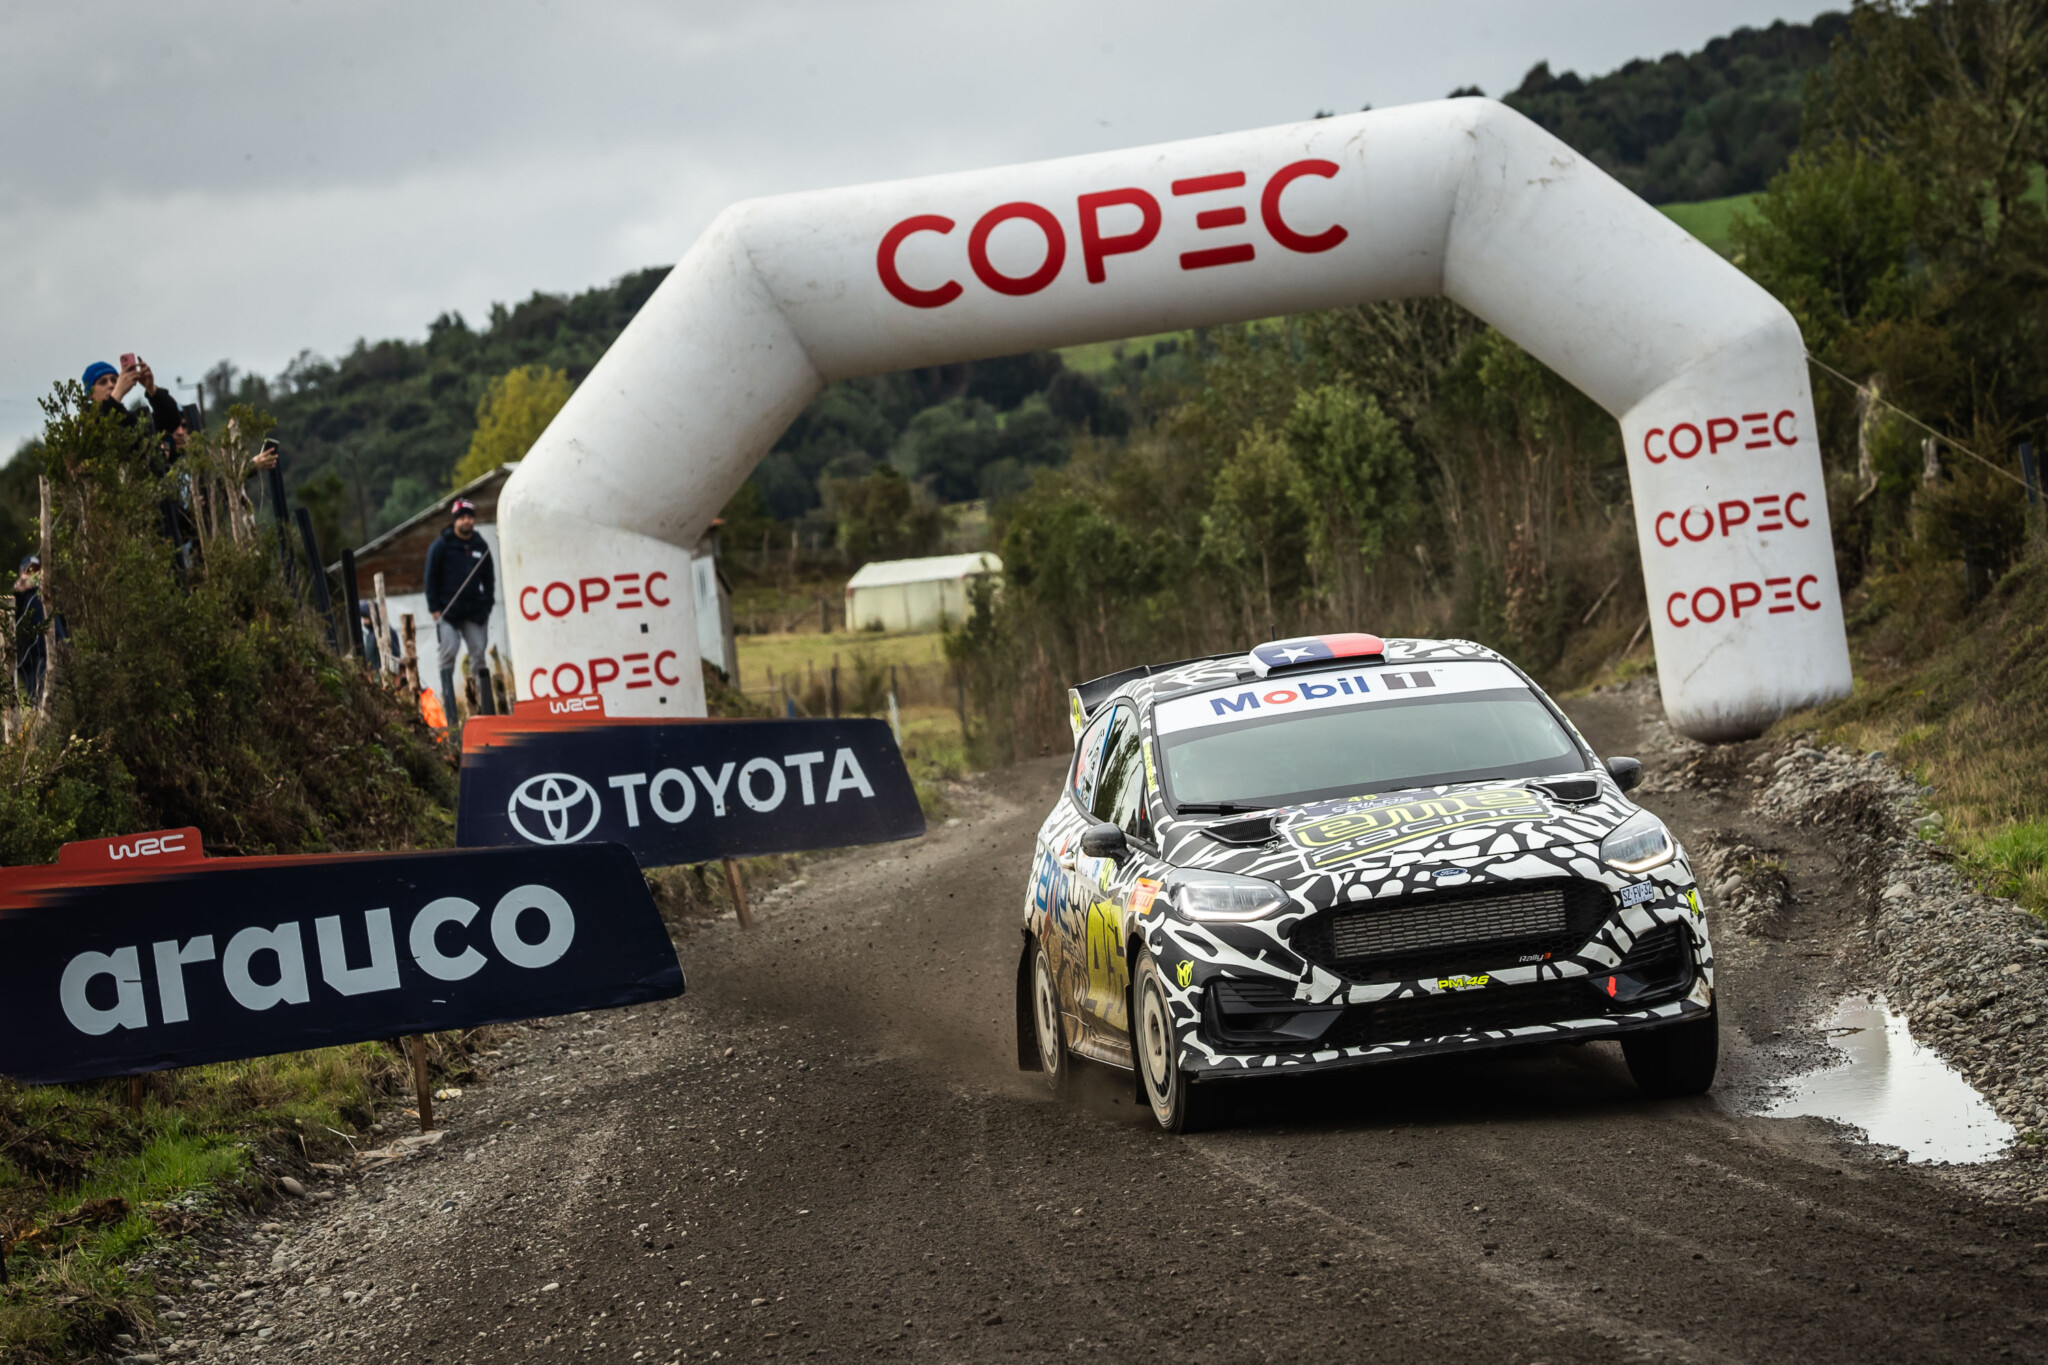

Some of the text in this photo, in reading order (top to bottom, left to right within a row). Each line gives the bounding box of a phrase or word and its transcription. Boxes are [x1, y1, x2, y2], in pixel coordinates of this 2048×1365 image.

[877, 158, 1348, 309] COPEC
[1644, 410, 1798, 464] COPEC
[1655, 492, 1810, 547] COPEC
[520, 571, 670, 622] COPEC
[1667, 574, 1821, 628] COPEC
[530, 650, 680, 699] COPEC
[1209, 675, 1371, 716] Mobil
[549, 695, 600, 715] WRC
[608, 747, 875, 827] TOYOTA
[108, 834, 186, 860] WRC
[59, 883, 576, 1036] arauco
